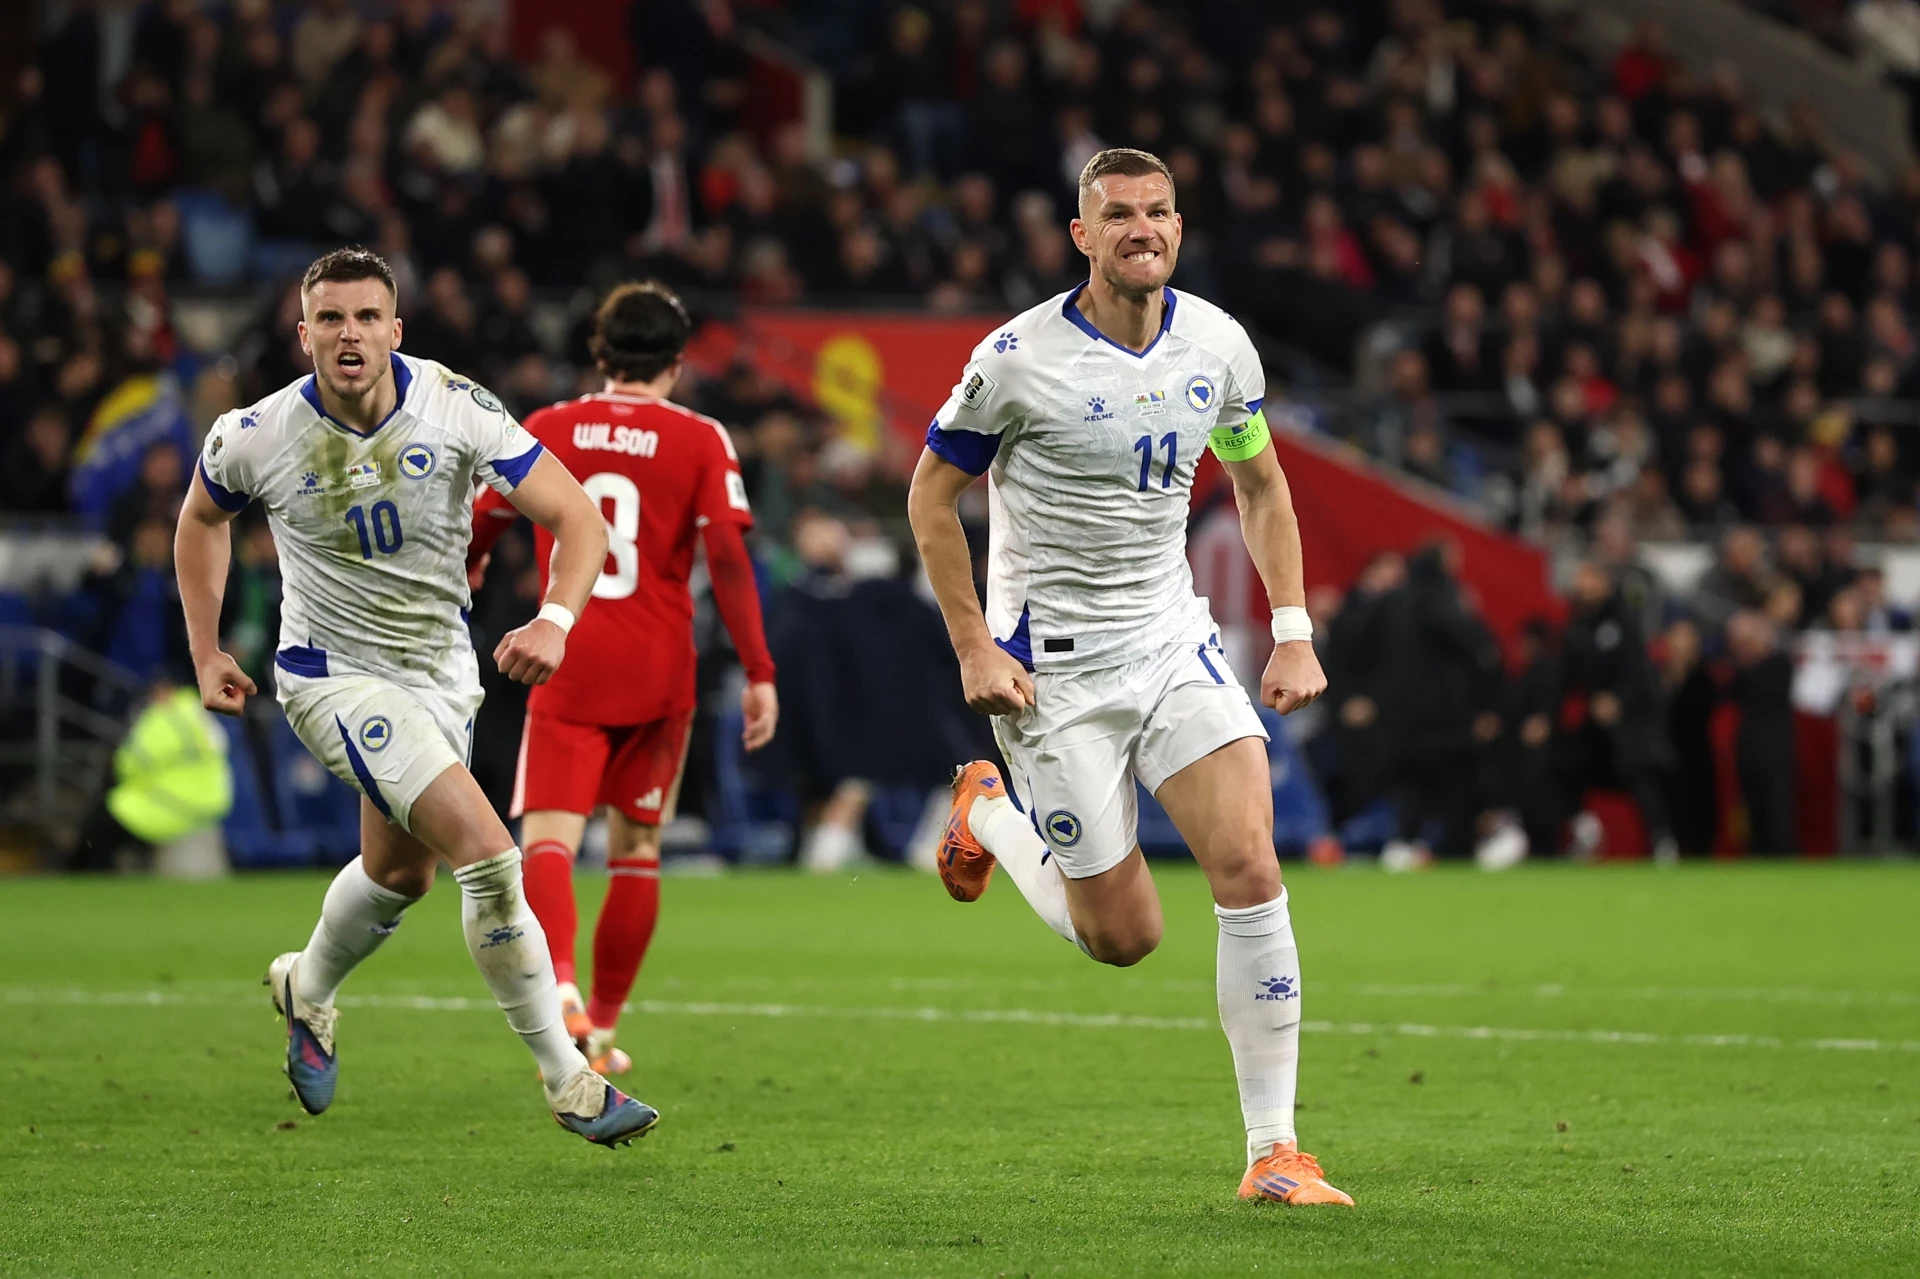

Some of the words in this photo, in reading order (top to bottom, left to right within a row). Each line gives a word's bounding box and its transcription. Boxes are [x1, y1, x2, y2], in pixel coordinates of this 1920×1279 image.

[1084, 412, 1114, 423] KELME
[572, 422, 659, 459] WILSON
[1224, 424, 1260, 448] RESPECT
[1134, 431, 1177, 492] 11
[297, 487, 327, 495] KELME
[345, 500, 404, 560] 10
[581, 471, 641, 600] 8
[1255, 990, 1299, 1001] KELME
